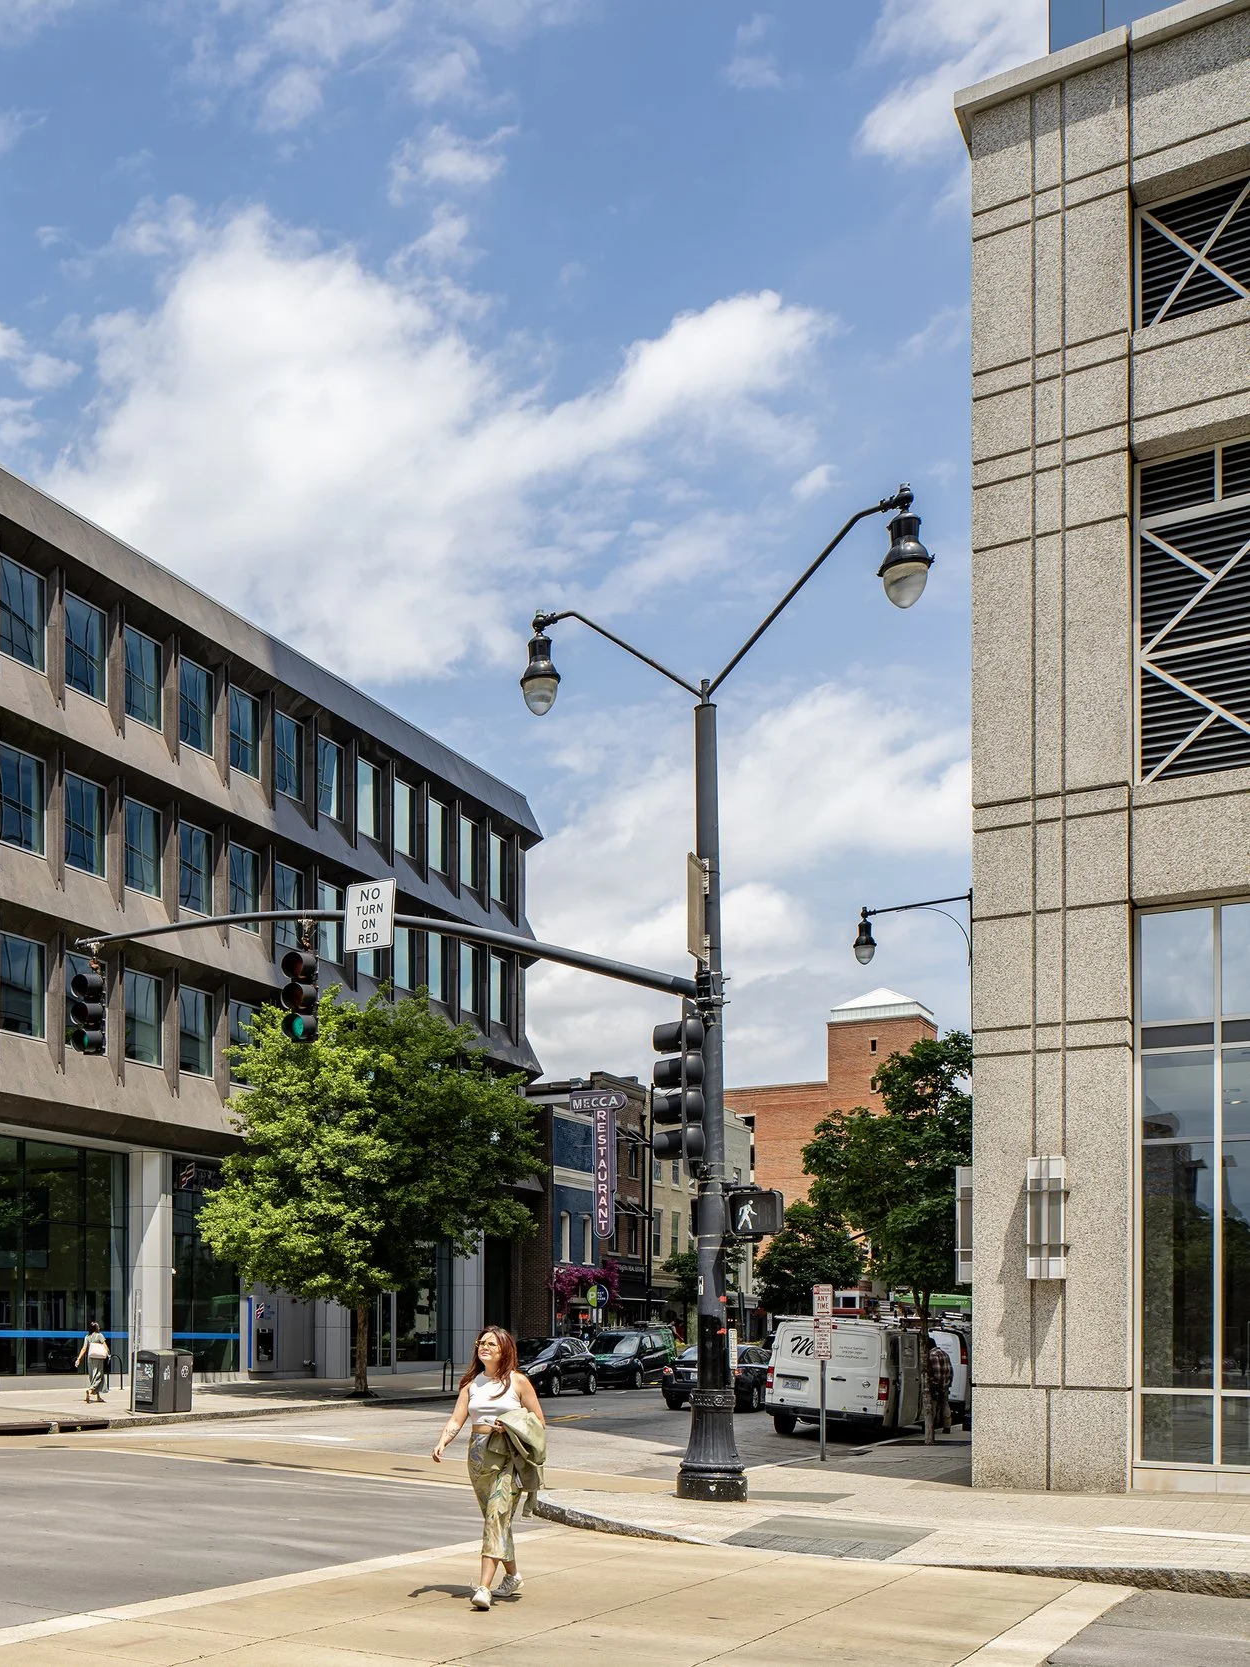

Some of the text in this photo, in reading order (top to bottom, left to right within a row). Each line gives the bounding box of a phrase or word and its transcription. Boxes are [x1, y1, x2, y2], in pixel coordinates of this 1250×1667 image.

[360, 887, 381, 902] NO
[356, 902, 384, 917] TURN
[361, 918, 376, 930] ON
[358, 932, 379, 945] RED
[572, 1096, 619, 1110] MECCA
[596, 1110, 609, 1231] RESTAURANT
